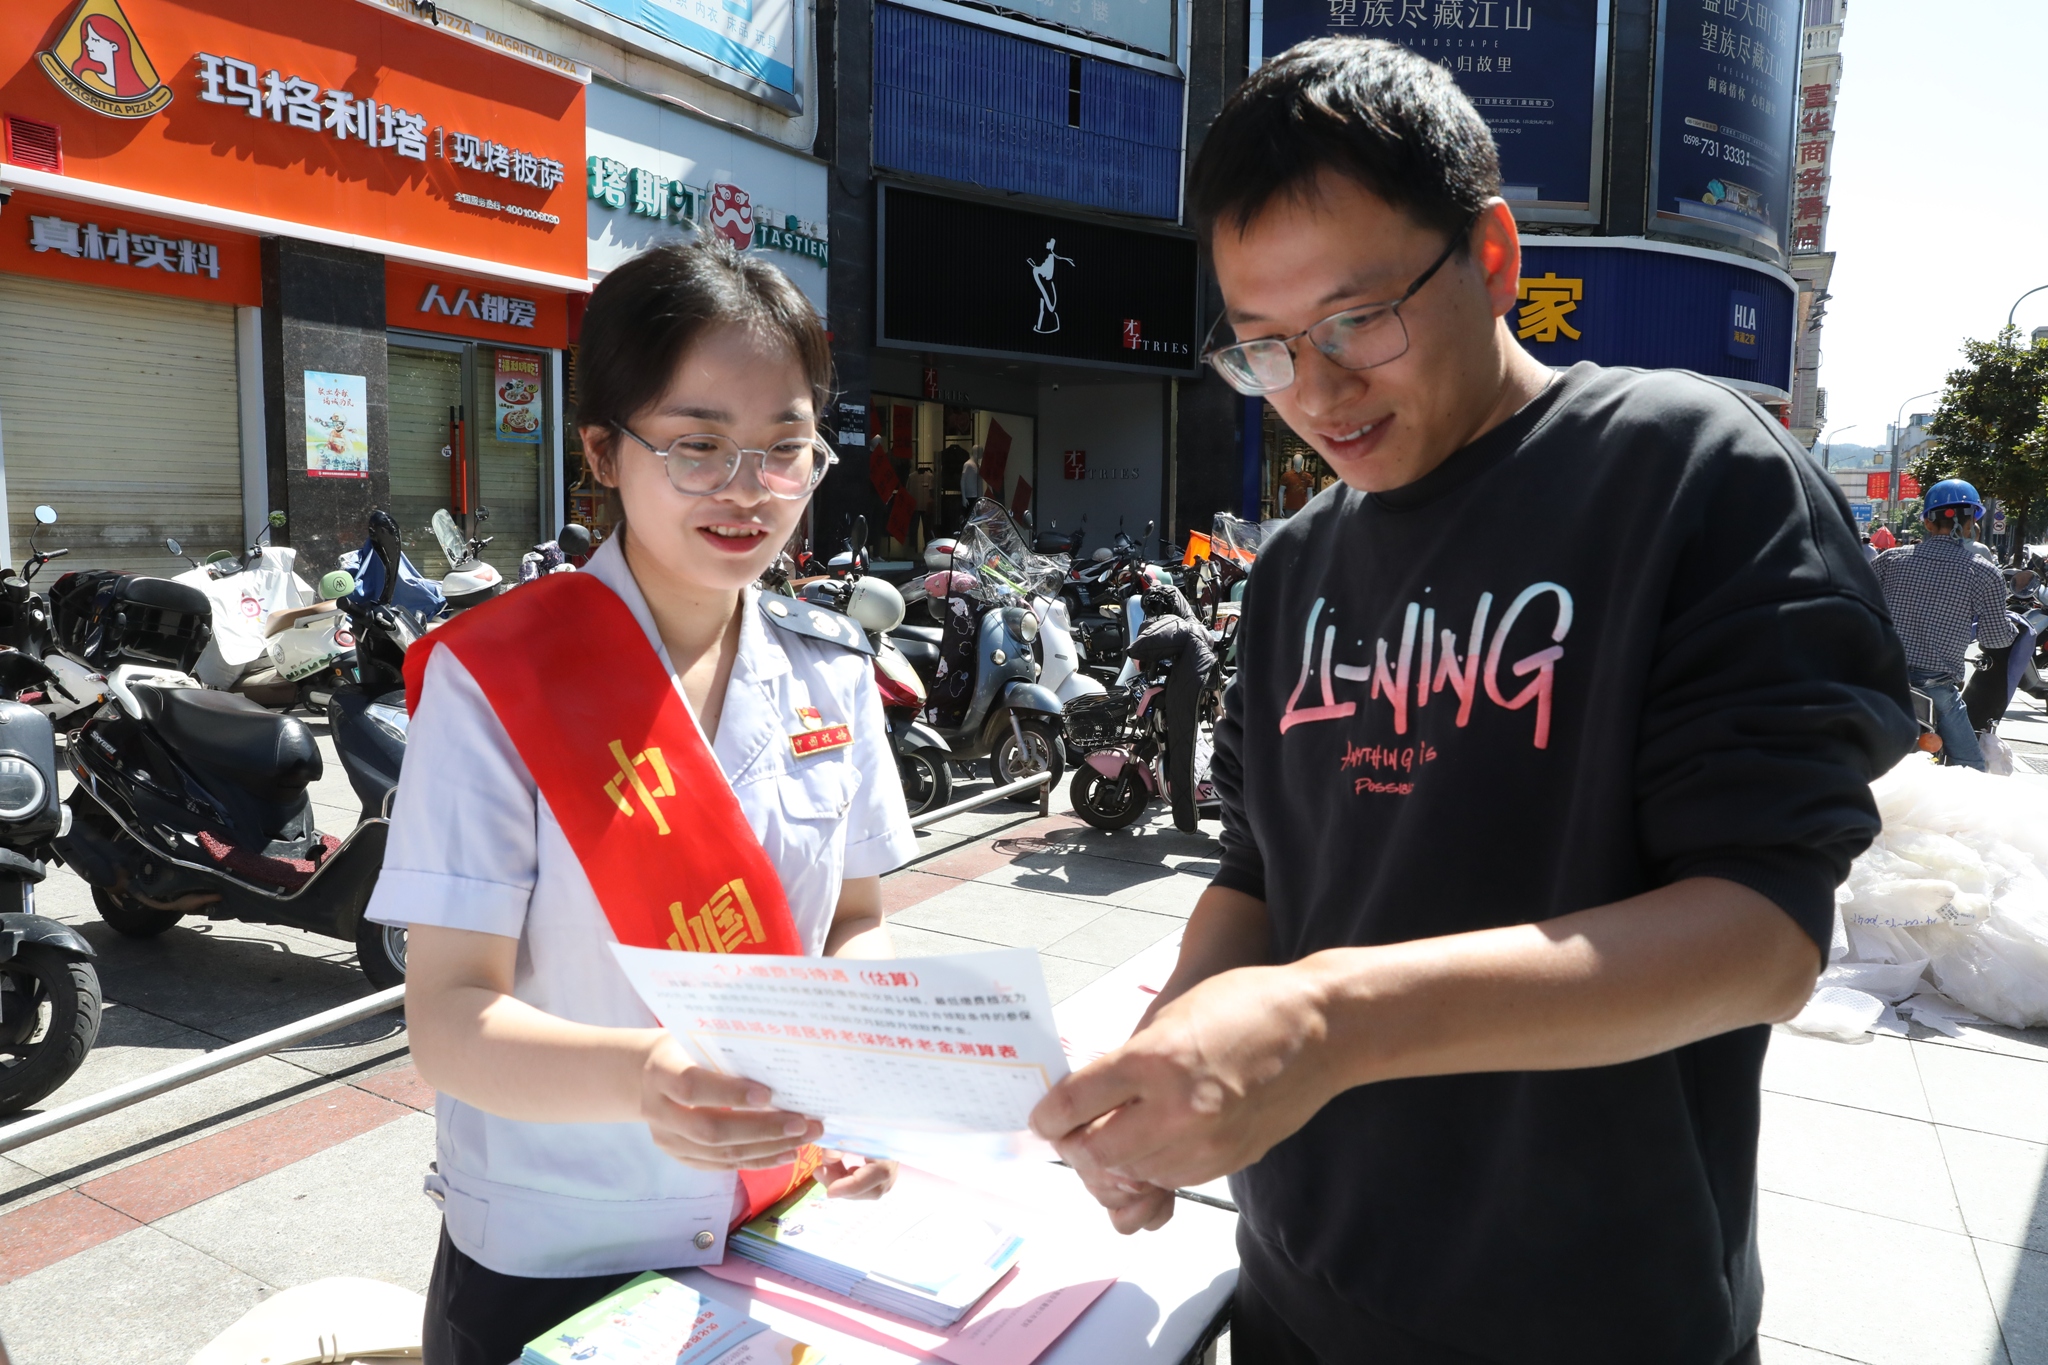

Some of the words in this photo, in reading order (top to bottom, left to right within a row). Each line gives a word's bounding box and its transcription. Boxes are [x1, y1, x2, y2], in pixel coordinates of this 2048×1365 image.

[695, 2, 718, 23] 内衣
[726, 16, 748, 39] 床品
[755, 29, 777, 52] 玩具
[1327, 0, 1532, 31] 望族尽藏江山
[485, 30, 544, 61] MAGRITTA
[546, 54, 576, 75] PIZZA
[1700, 20, 1783, 86] 望族尽藏江山
[61, 77, 123, 114] MAGRITTA
[124, 101, 156, 114] PIZZA
[200, 52, 428, 162] 玛格利塔
[453, 132, 564, 190] 现烤披萨
[1683, 133, 1719, 157] 0598-731
[1723, 144, 1745, 166] 3333
[1794, 83, 1832, 248] 富华商务酒店
[590, 156, 706, 225] 塔斯汀
[30, 215, 220, 279] 真材实料
[761, 225, 828, 262] TASTIEN
[420, 284, 536, 328] 人人都爱
[1516, 272, 1583, 342] 家
[1734, 304, 1756, 330] HLA
[1143, 340, 1188, 354] TRIES
[1087, 467, 1140, 480] TRIES
